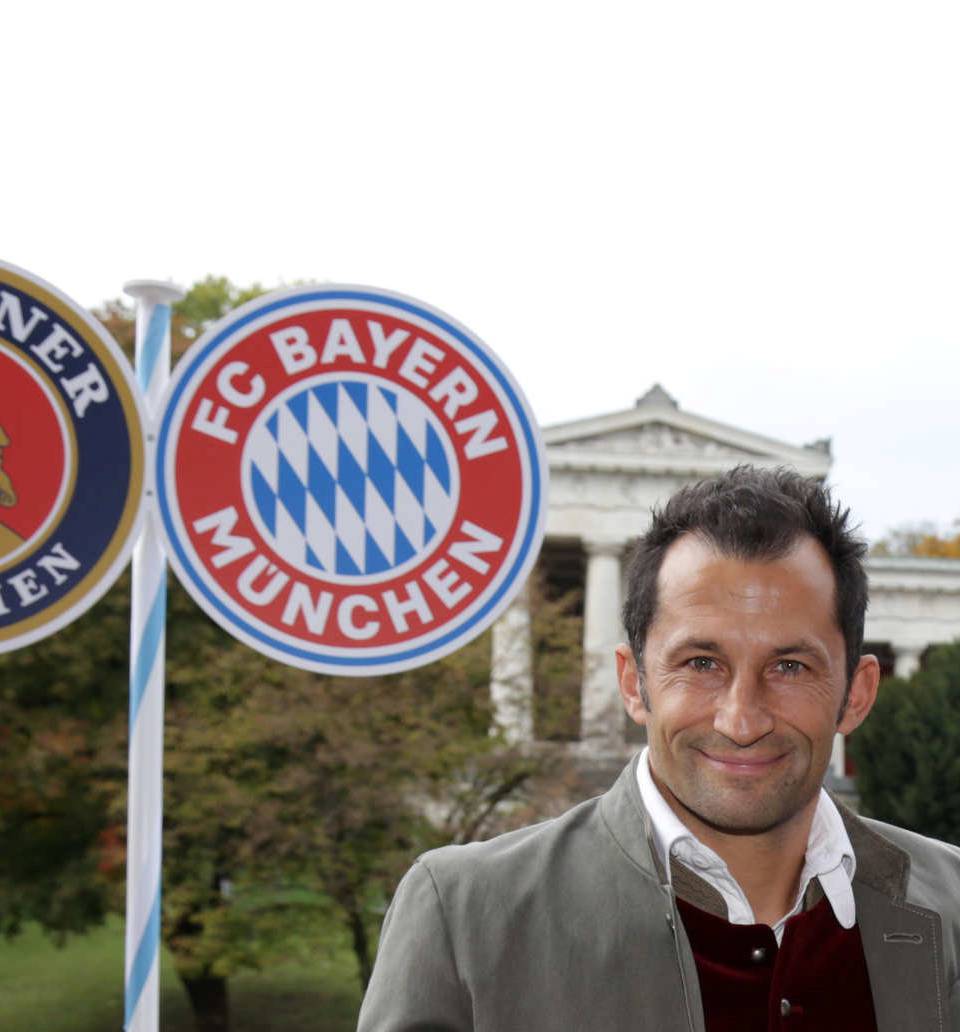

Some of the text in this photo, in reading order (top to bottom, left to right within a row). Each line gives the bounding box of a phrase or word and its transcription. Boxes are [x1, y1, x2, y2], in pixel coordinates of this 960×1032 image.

[192, 318, 509, 460] FC BAYERN
[192, 505, 503, 641] MÜNCHEN
